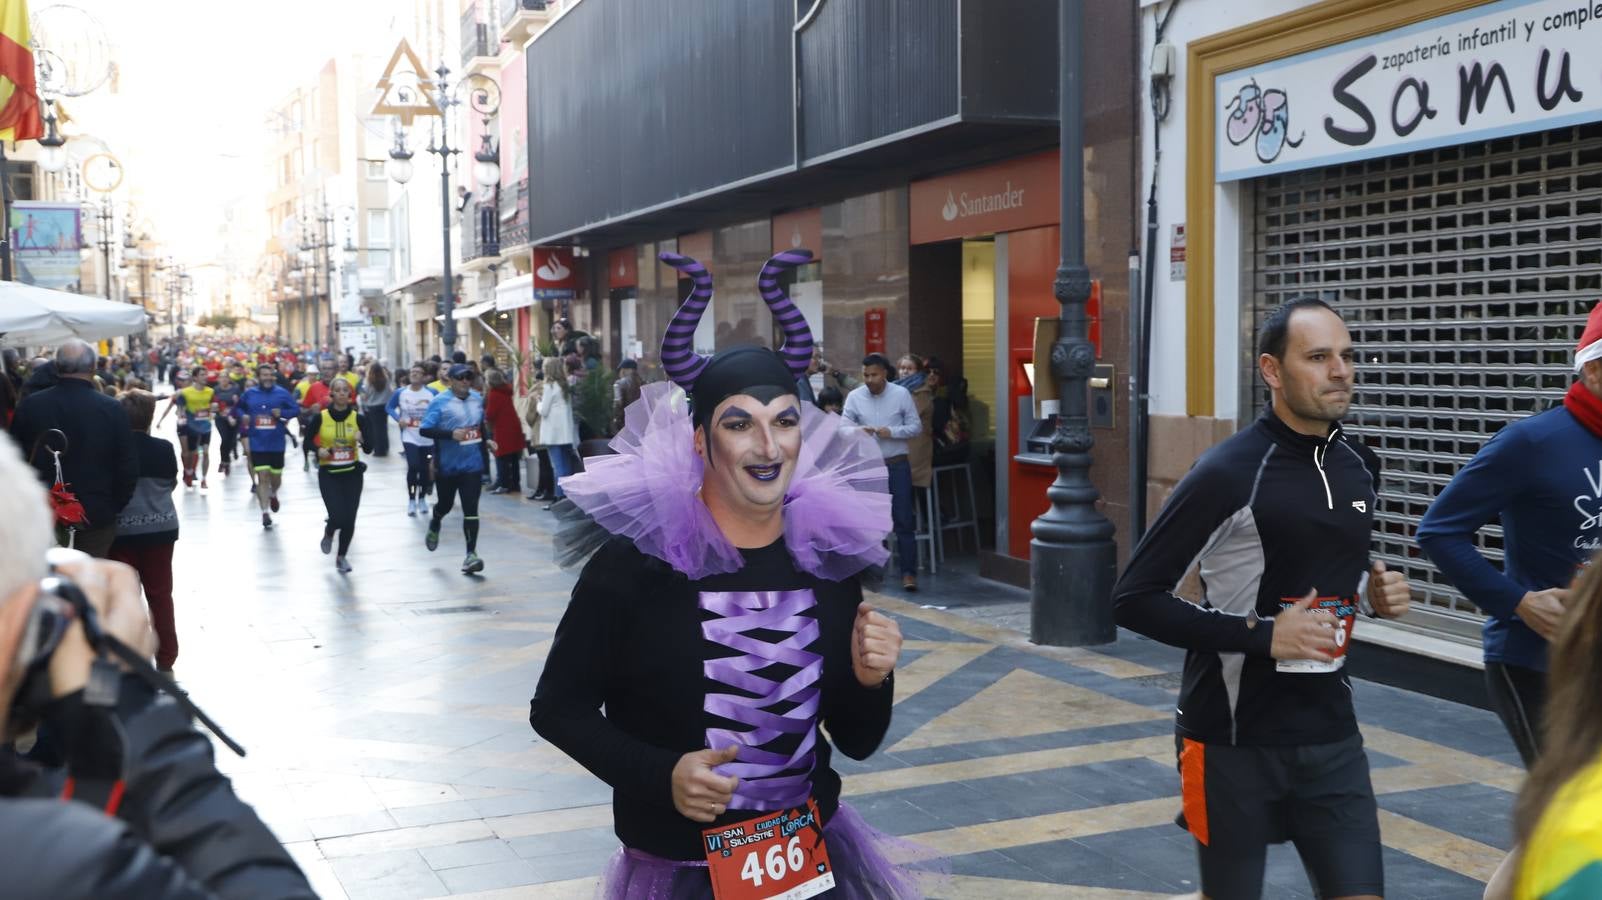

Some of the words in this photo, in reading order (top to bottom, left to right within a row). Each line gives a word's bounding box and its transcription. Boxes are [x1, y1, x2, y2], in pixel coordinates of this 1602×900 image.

[1382, 35, 1451, 71] zapatería
[1457, 18, 1517, 52] infantil
[1524, 19, 1536, 43] y
[1543, 0, 1602, 32] comple
[1324, 48, 1584, 147] Samu
[959, 180, 1025, 218] Santander
[706, 835, 722, 851] VI
[723, 827, 745, 839] SAN
[729, 829, 775, 848] SILVESTRE
[741, 835, 804, 887] 466
